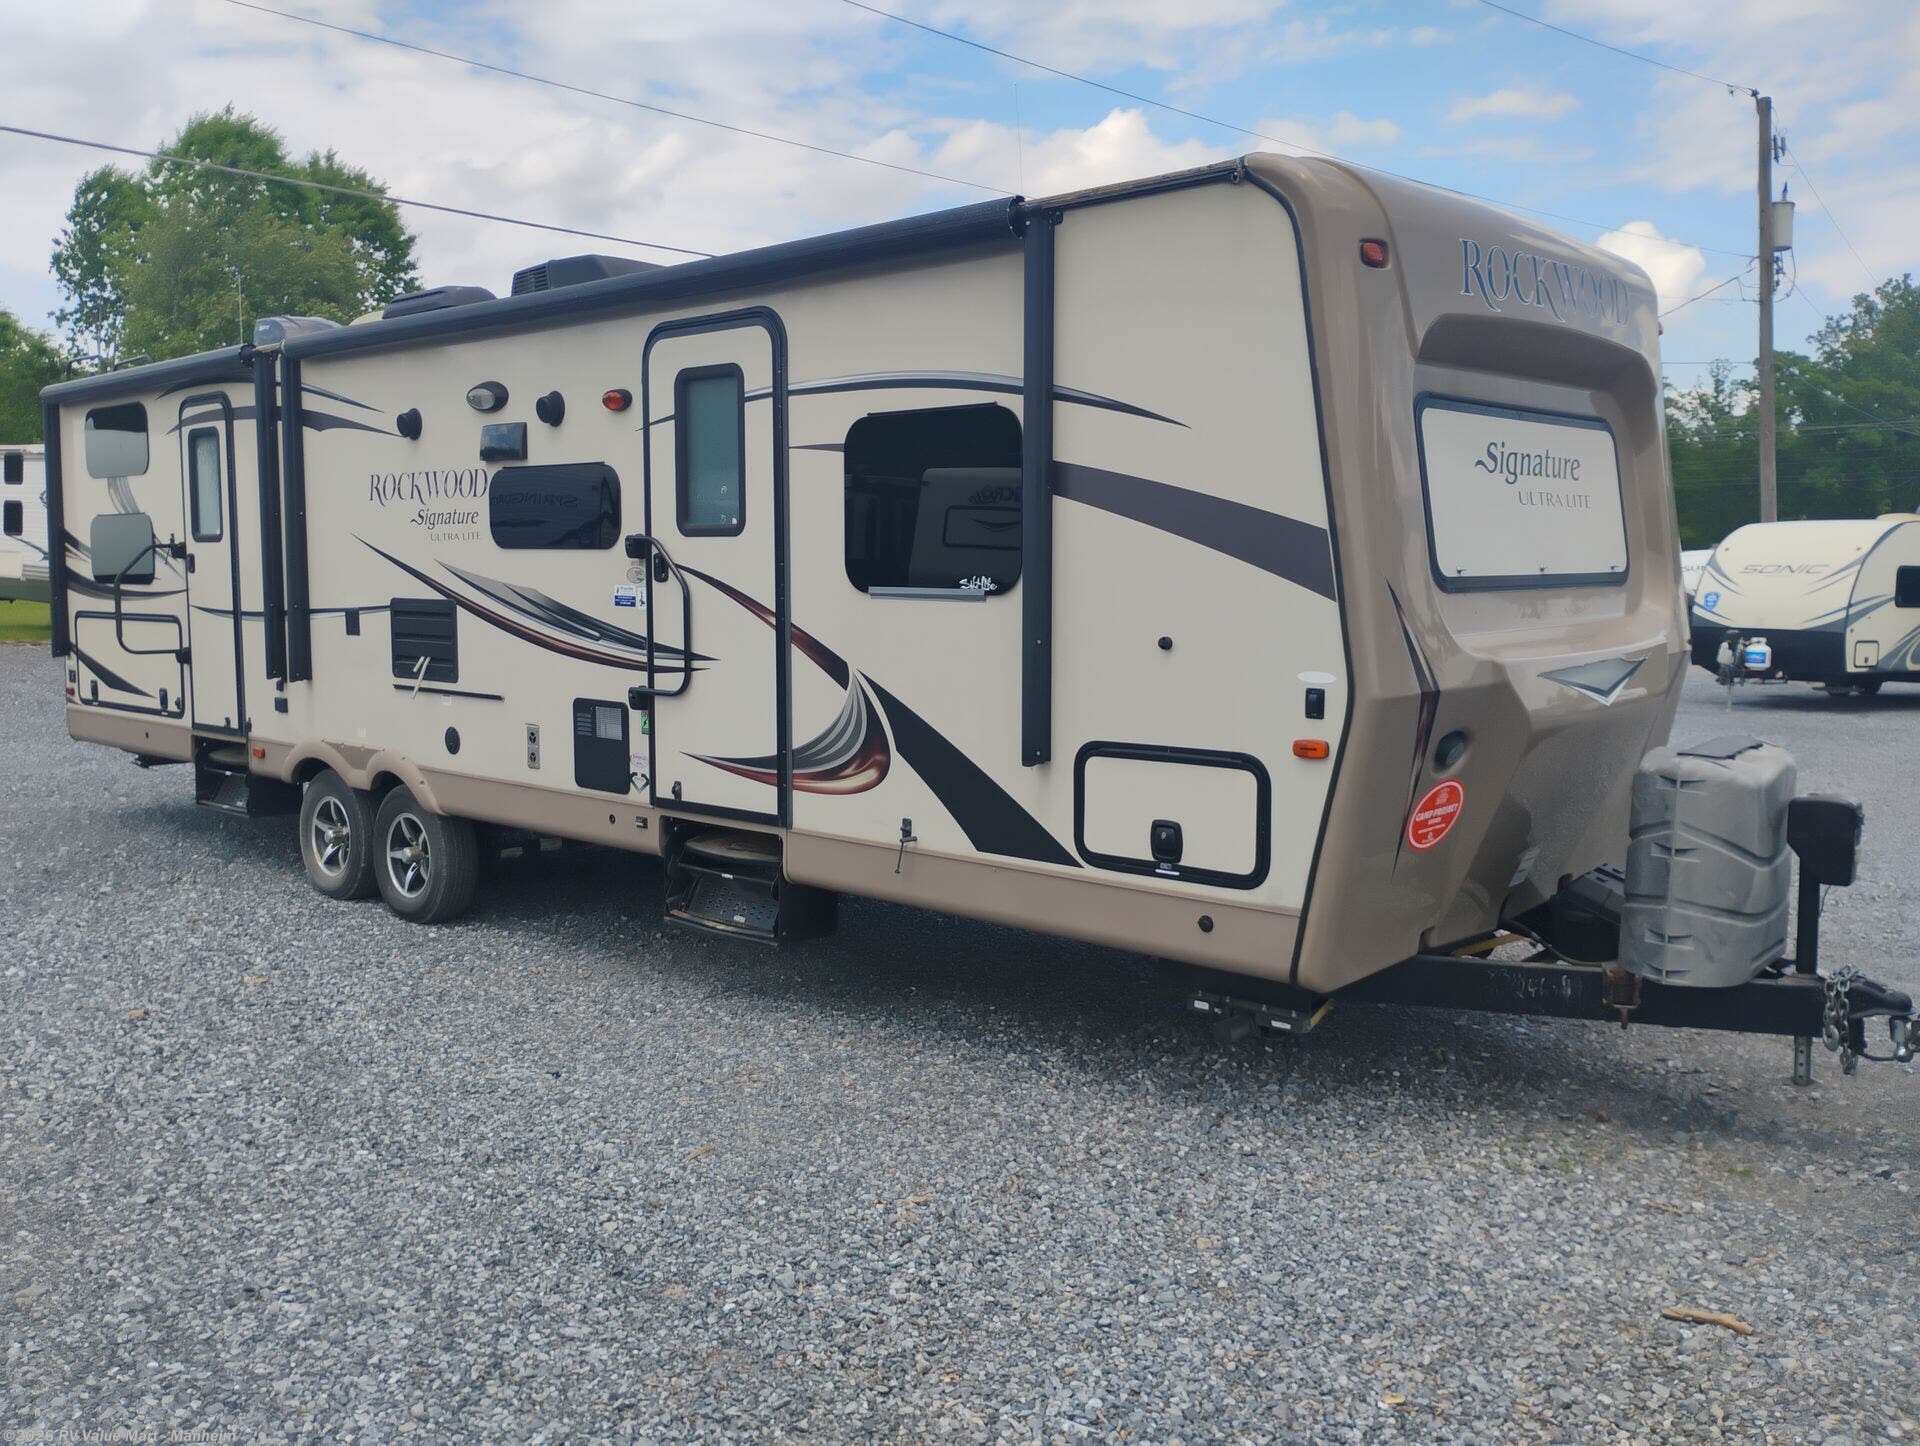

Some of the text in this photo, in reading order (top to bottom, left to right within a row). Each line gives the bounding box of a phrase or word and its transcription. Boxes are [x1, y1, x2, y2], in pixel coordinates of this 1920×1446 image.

[1459, 237, 1630, 326] ROCKWOOD
[1475, 441, 1581, 485] Signature
[369, 468, 488, 507] ROCKWOOD
[1518, 491, 1591, 509] ULTRA LITE
[410, 508, 479, 530] Signature
[430, 531, 481, 542] ULTRA LITE
[1739, 564, 1830, 575] SONIC
